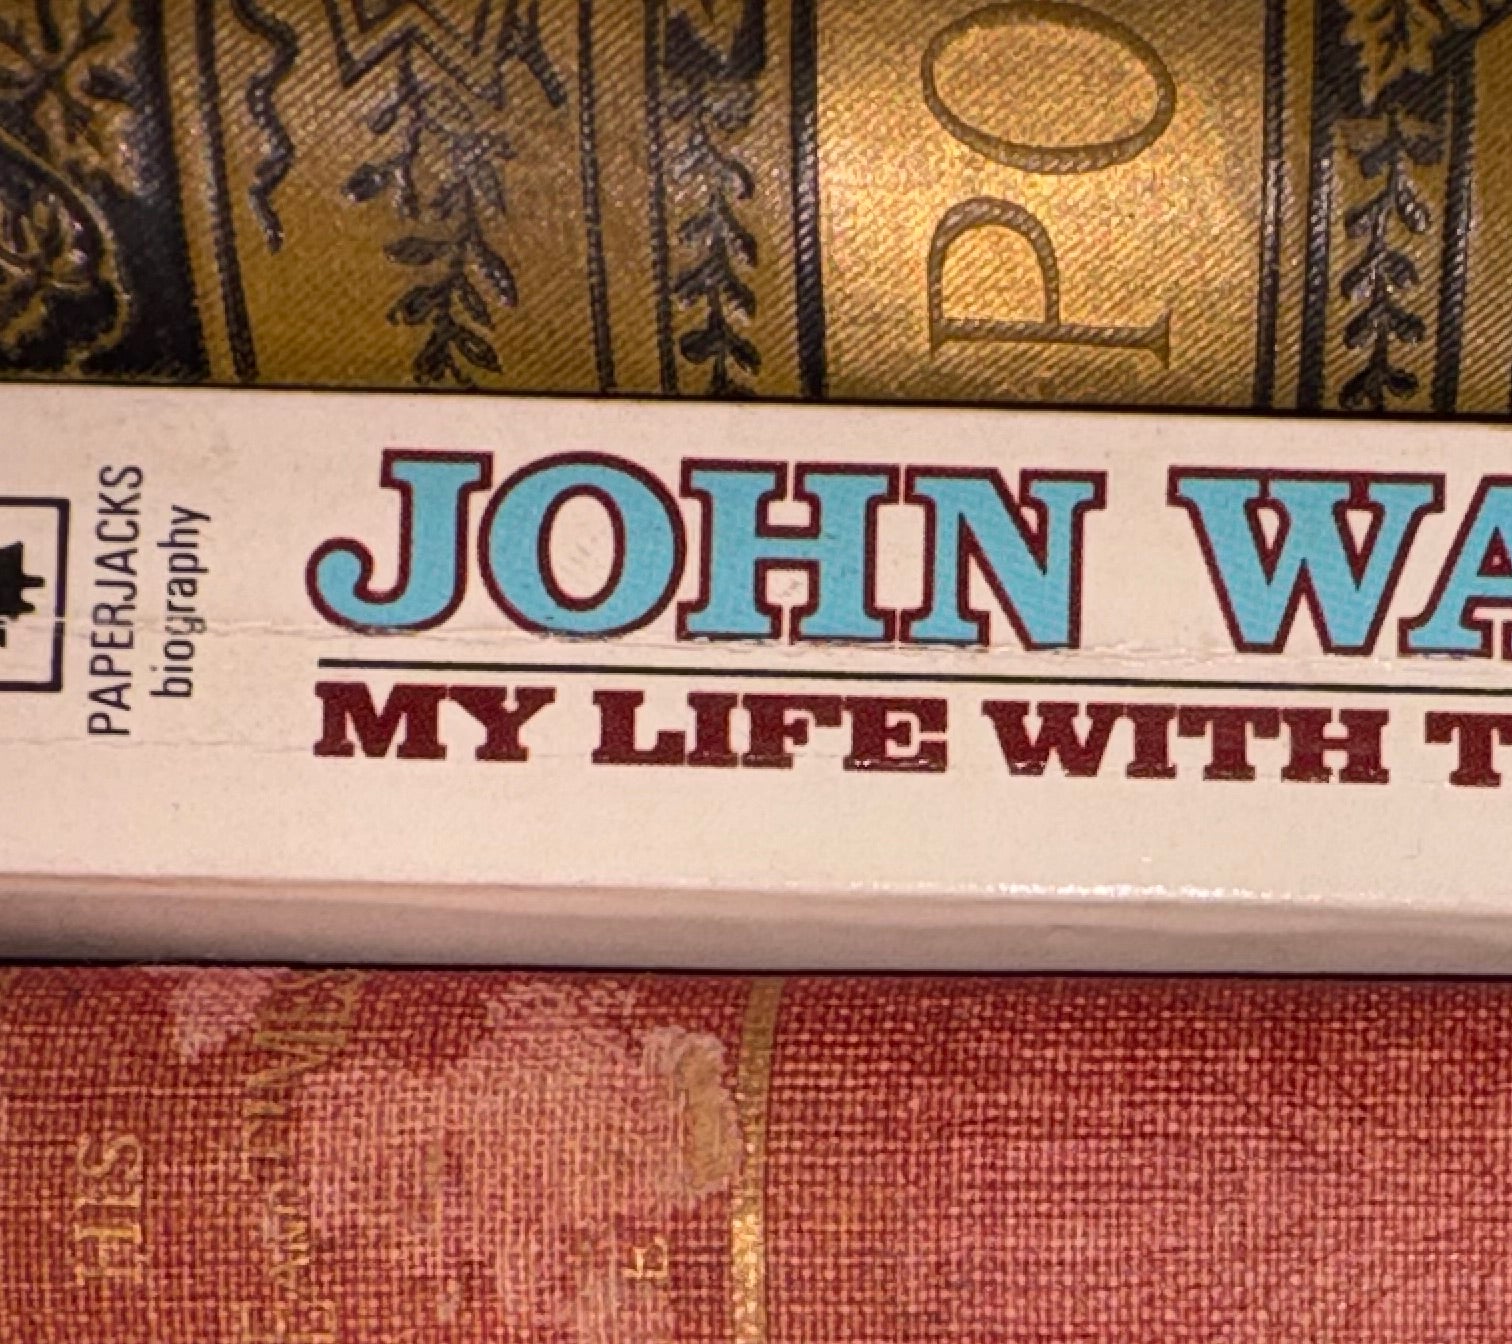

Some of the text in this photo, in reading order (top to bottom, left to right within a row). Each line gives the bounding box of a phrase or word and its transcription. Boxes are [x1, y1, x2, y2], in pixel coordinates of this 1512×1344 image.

[87, 463, 145, 736] PAPERJACKS
[150, 504, 212, 698] biography
[305, 449, 1107, 650] JOHN
[313, 682, 556, 762] MY
[592, 690, 948, 775] LIFE
[981, 700, 1390, 784] WITH
